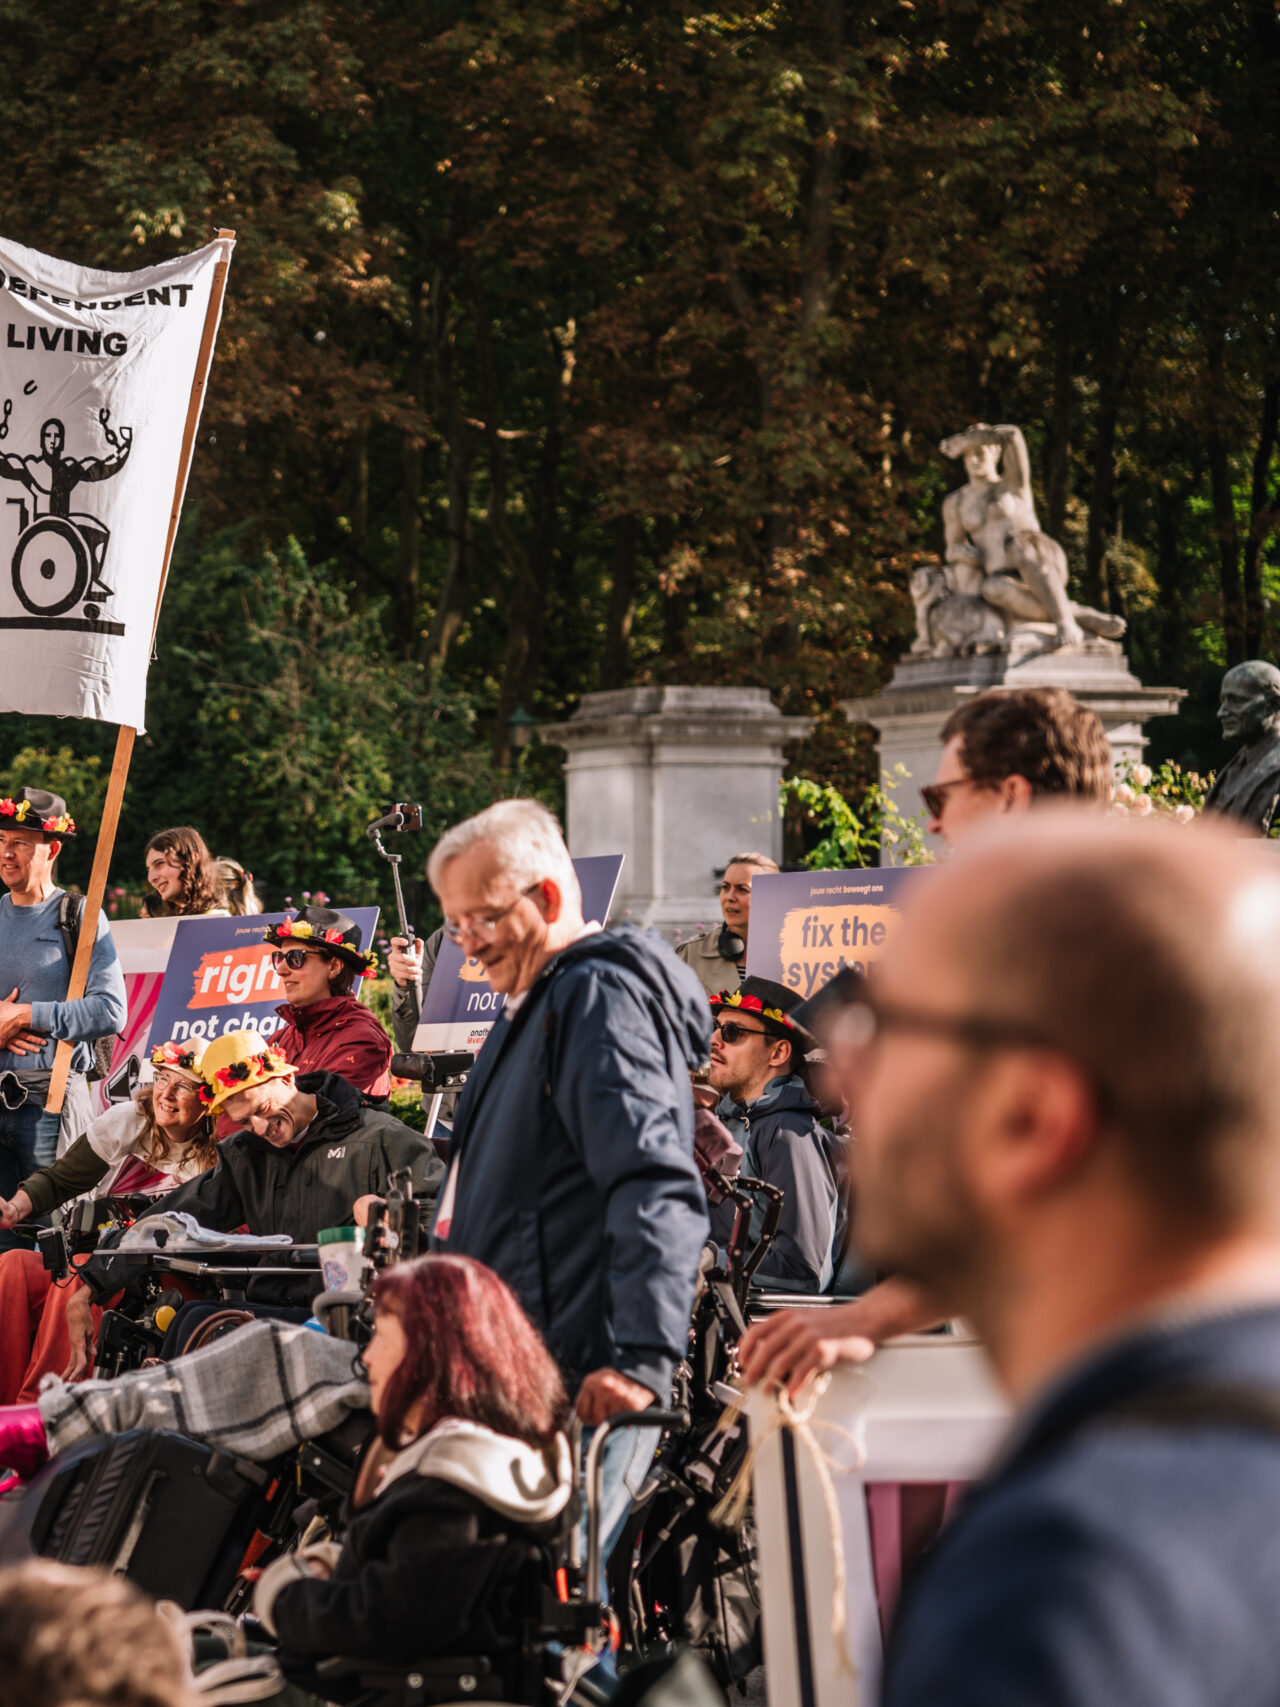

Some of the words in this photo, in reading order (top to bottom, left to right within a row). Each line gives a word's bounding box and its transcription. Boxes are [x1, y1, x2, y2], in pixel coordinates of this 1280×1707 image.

[7, 323, 127, 356] LIVING
[802, 915, 834, 947] fix
[841, 916, 886, 946] the
[467, 992, 499, 1011] not
[171, 1015, 219, 1040] not
